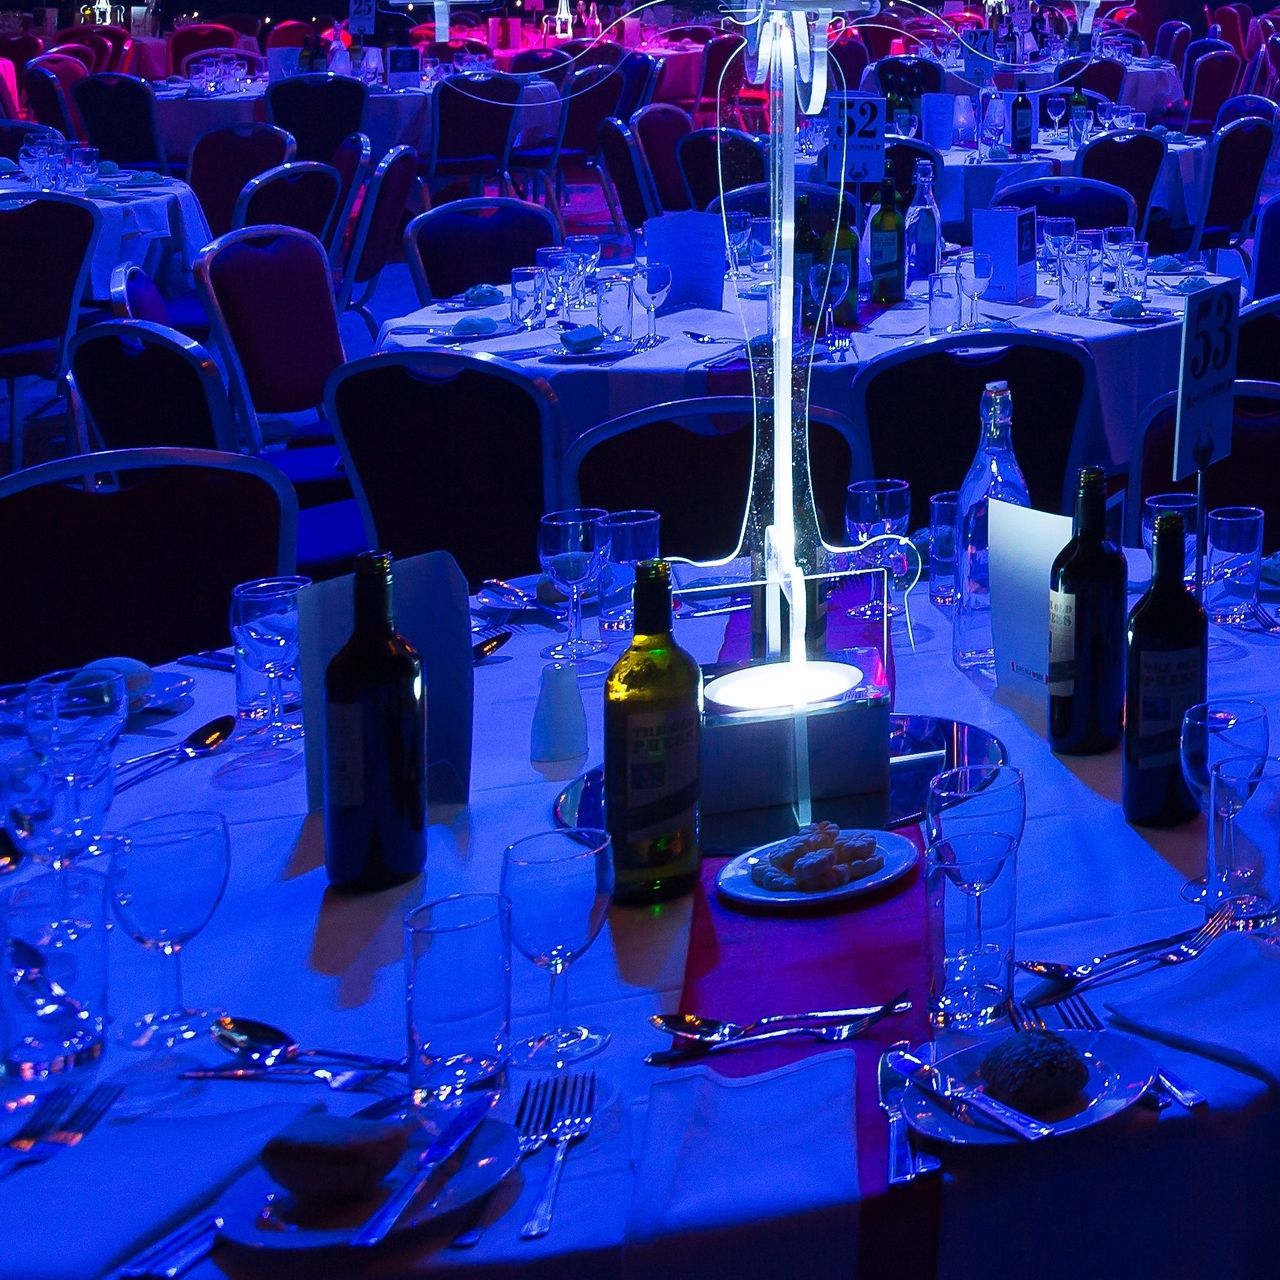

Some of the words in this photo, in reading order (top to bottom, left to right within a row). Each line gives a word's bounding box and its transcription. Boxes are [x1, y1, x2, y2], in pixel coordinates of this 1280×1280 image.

[968, 30, 991, 54] 27
[835, 101, 878, 139] 52
[1191, 292, 1233, 380] 53
